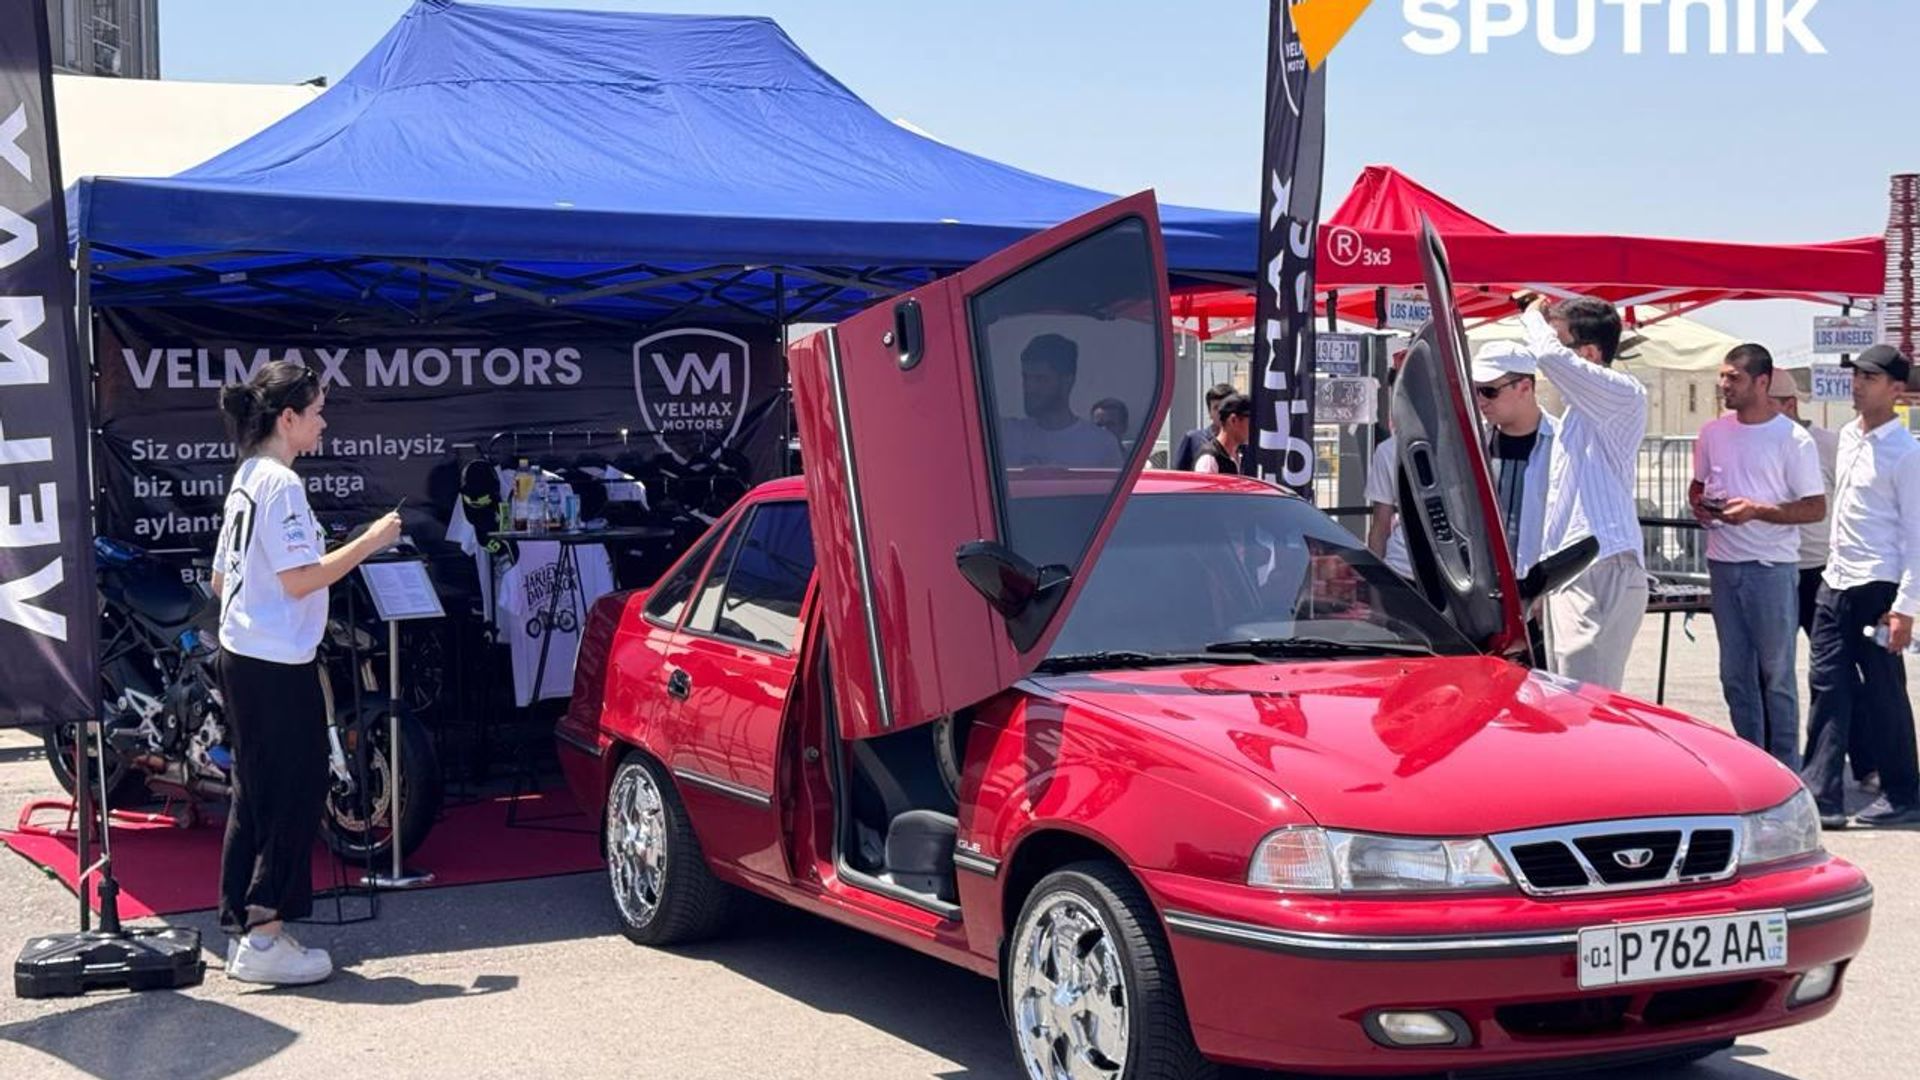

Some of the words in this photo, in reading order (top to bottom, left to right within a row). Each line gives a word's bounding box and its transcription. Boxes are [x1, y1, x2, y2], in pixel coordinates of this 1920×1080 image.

[1362, 248, 1391, 265] 3x3
[1408, 304, 1431, 321] ANGE
[1816, 330, 1833, 345] LOS
[1834, 330, 1873, 345] ANGELES
[365, 347, 582, 386] MOTORS
[651, 352, 731, 395] VM
[653, 402, 733, 417] VELMAX
[662, 419, 724, 430] MOTORS
[131, 438, 168, 460] Siz
[332, 434, 445, 460] tanlaysiz
[134, 475, 172, 498] biz
[181, 474, 224, 497] uni
[134, 510, 222, 541] aylant
[1590, 946, 1612, 968] 01
[1650, 926, 1712, 972] 762
[1721, 920, 1766, 965] AA
[1768, 947, 1783, 960] UZ
